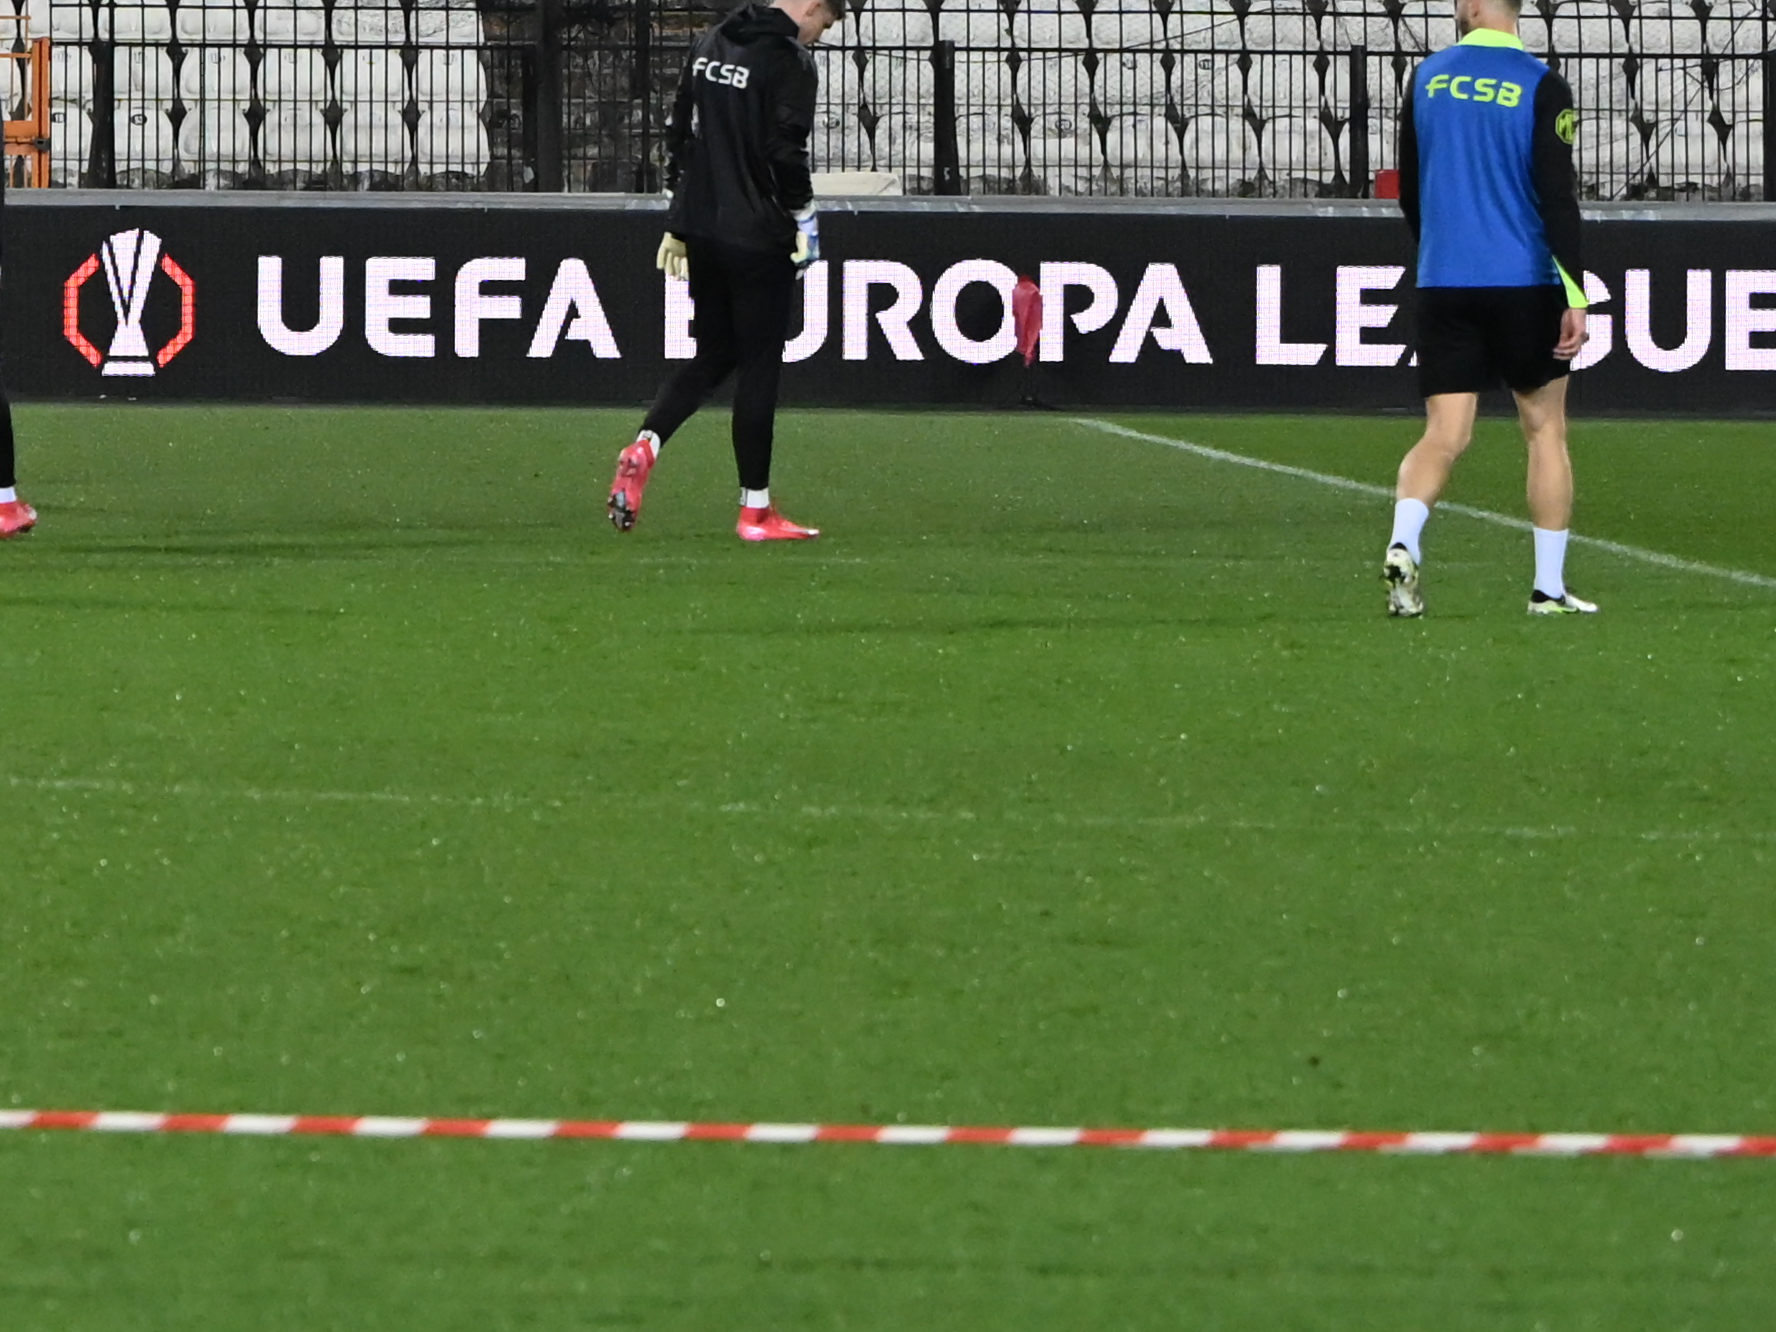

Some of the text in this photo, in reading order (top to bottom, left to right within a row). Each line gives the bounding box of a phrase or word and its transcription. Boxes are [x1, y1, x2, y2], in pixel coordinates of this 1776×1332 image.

[692, 56, 750, 89] FCSB
[1425, 73, 1523, 107] FCSB
[257, 255, 622, 359] UEFA
[1255, 264, 1776, 373] LEUE
